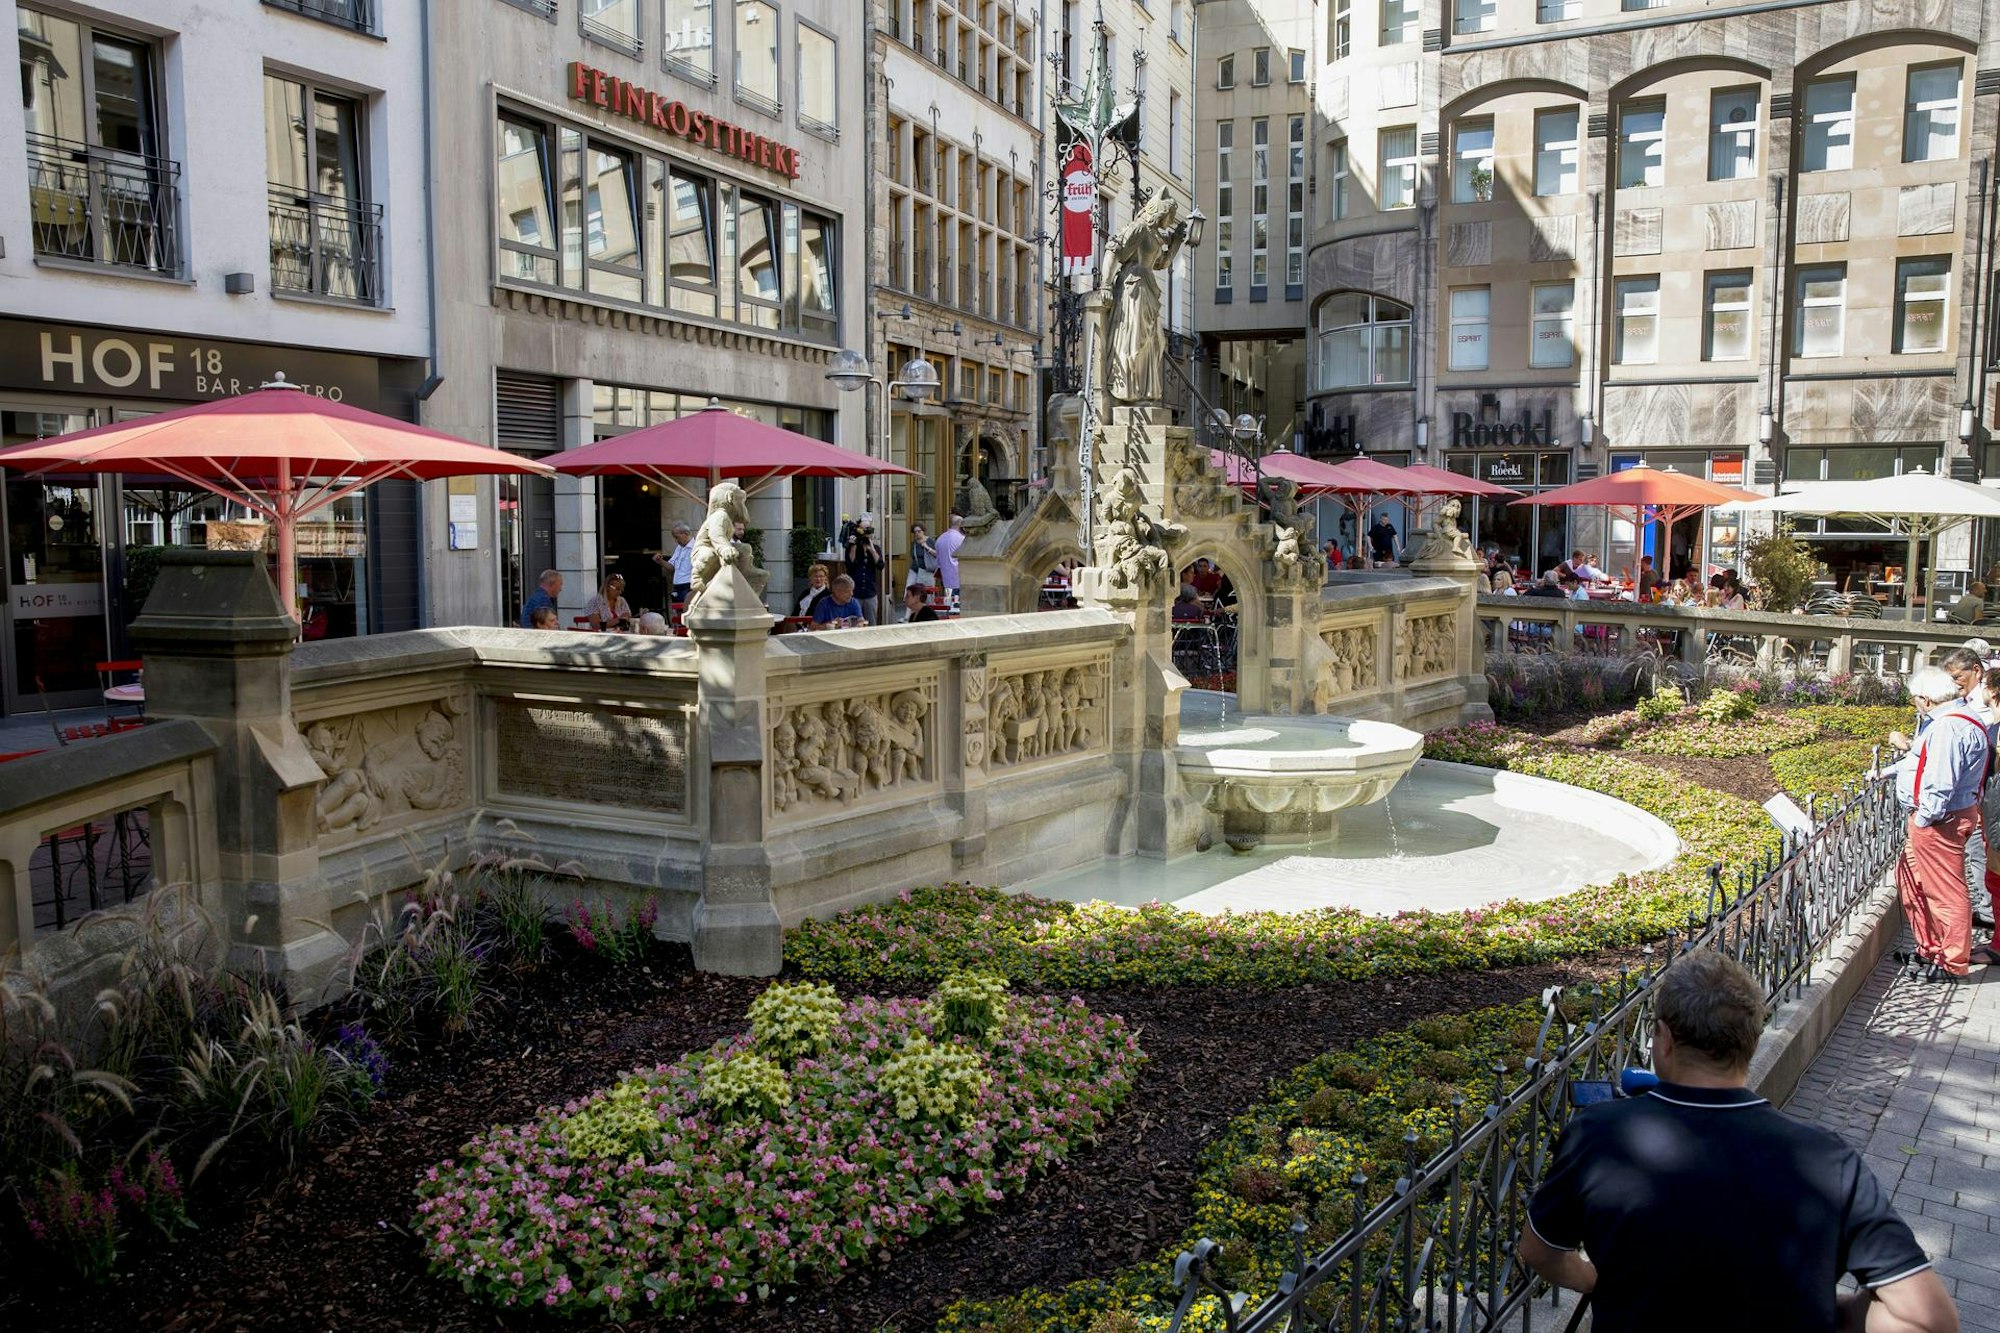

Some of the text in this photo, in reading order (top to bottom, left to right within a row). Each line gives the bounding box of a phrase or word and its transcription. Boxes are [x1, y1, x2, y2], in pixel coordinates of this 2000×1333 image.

[568, 61, 801, 180] FEINKOSTTHEKE
[1458, 334, 1482, 343] ESPRIT
[1538, 331, 1564, 340] ESPRIT
[40, 332, 223, 390] HOF 18
[1451, 409, 1552, 448] Roeckl
[20, 595, 54, 608] HOF
